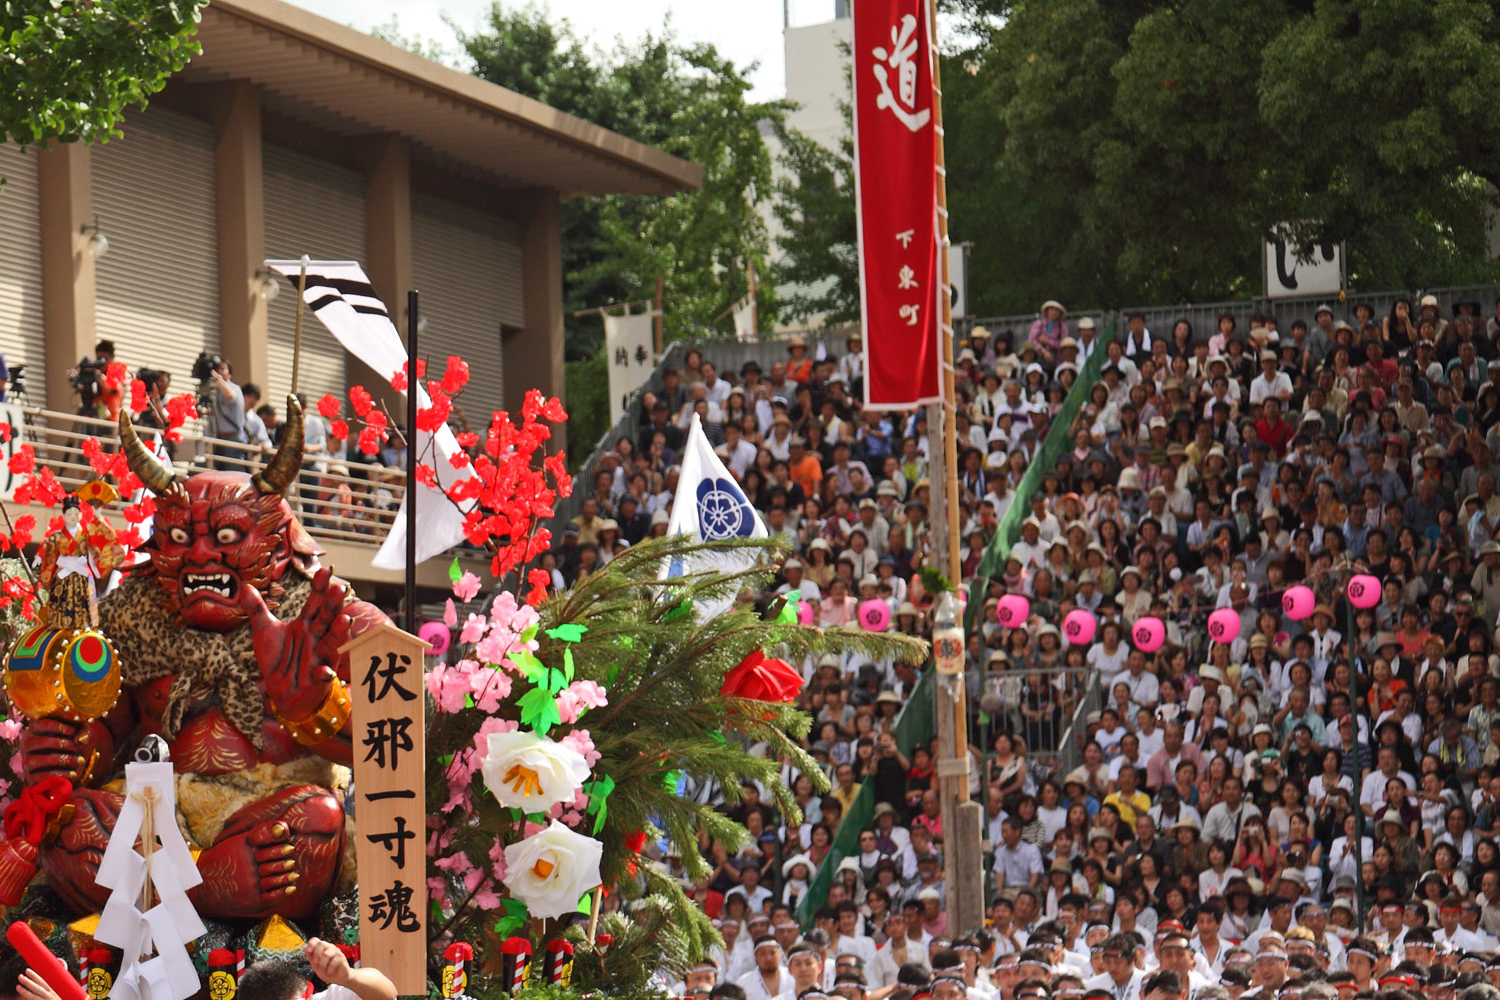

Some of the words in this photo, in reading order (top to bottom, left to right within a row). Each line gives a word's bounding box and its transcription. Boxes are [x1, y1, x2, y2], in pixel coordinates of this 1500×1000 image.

[871, 14, 931, 133] 道
[896, 229, 920, 326] 下東町
[361, 652, 421, 933] 伏邪一寸魂
